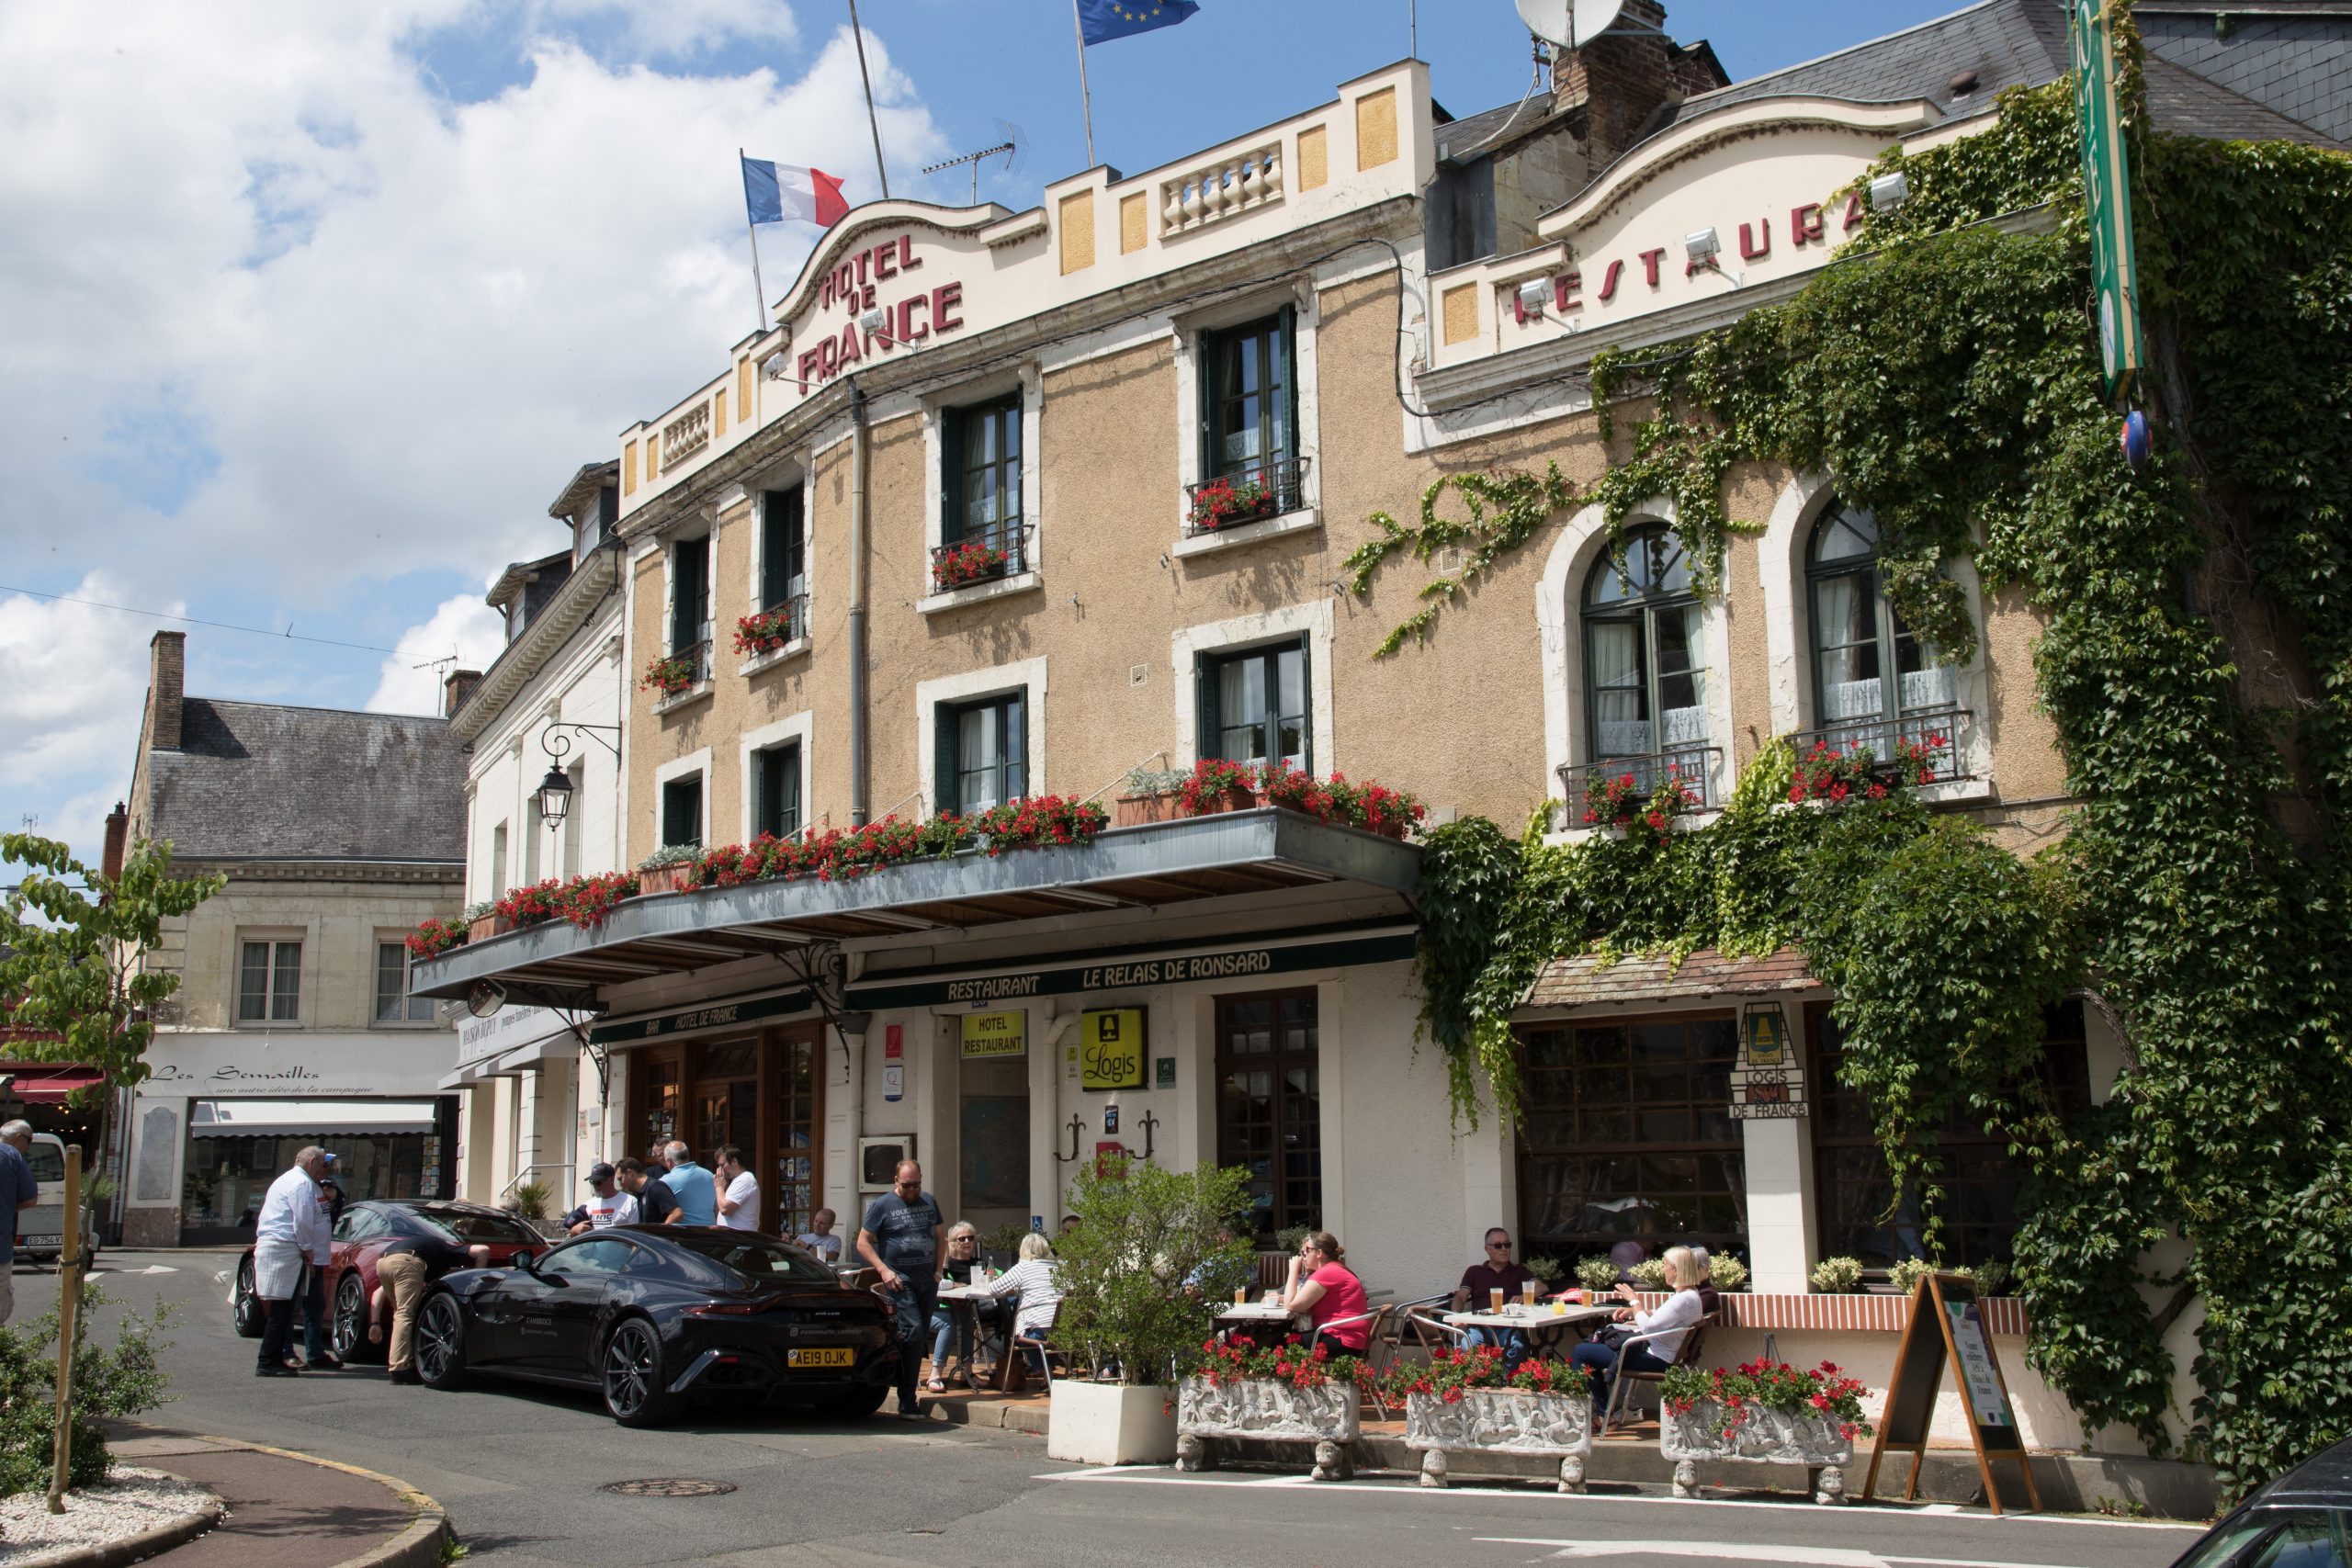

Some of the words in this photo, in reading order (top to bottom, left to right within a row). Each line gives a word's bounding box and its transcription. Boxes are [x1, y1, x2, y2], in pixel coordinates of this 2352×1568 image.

[821, 234, 922, 310] HOTEL
[848, 284, 876, 315] DE
[797, 281, 964, 395] FRANCE
[1083, 968, 1101, 988] LE
[1104, 961, 1159, 987] RELAIS
[1164, 959, 1185, 980] DE
[1190, 951, 1271, 978] RONSARD
[948, 976, 1040, 1001] RESTAURANT
[645, 1020, 661, 1035] BAR
[674, 1012, 698, 1030] HOTEL
[699, 1010, 708, 1028] DE
[708, 1005, 739, 1026] FRANCE
[978, 1016, 1007, 1032] HOTEL
[964, 1036, 1022, 1054] RESTAURANT
[1084, 1043, 1136, 1083] Logis
[142, 1065, 194, 1084] Les
[207, 1066, 320, 1080] Semailles
[1746, 1070, 1788, 1084] LOGIS
[321, 1087, 374, 1096] campagne
[1733, 1105, 1748, 1118] DE
[1755, 1102, 1806, 1117] FRANCE
[788, 1350, 797, 1359] GB
[796, 1351, 821, 1365] AE19
[824, 1350, 846, 1365] OJK
